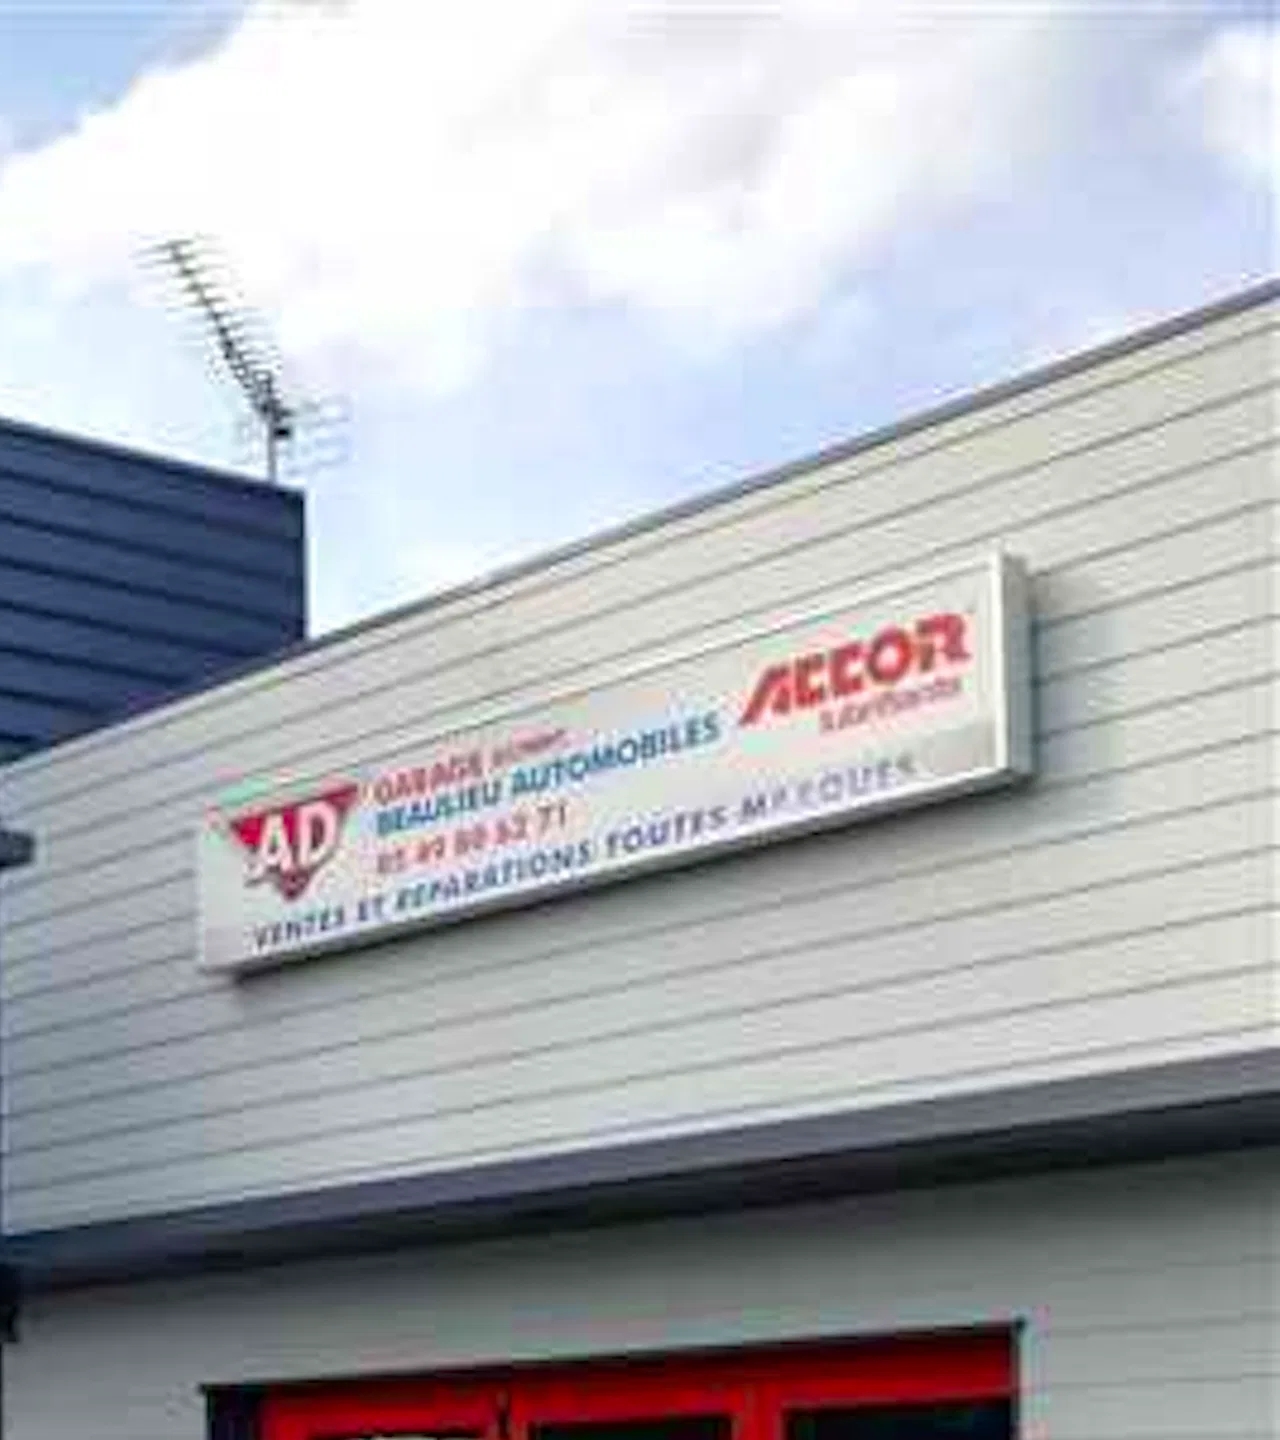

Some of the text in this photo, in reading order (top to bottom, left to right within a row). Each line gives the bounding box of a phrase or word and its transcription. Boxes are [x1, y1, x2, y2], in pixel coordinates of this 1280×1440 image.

[739, 612, 971, 727] ACCOR
[376, 779, 504, 838] BEAULIEU
[510, 711, 722, 795] AUTOMOBILES
[243, 800, 339, 884] AD
[605, 804, 727, 858] TOUTES
